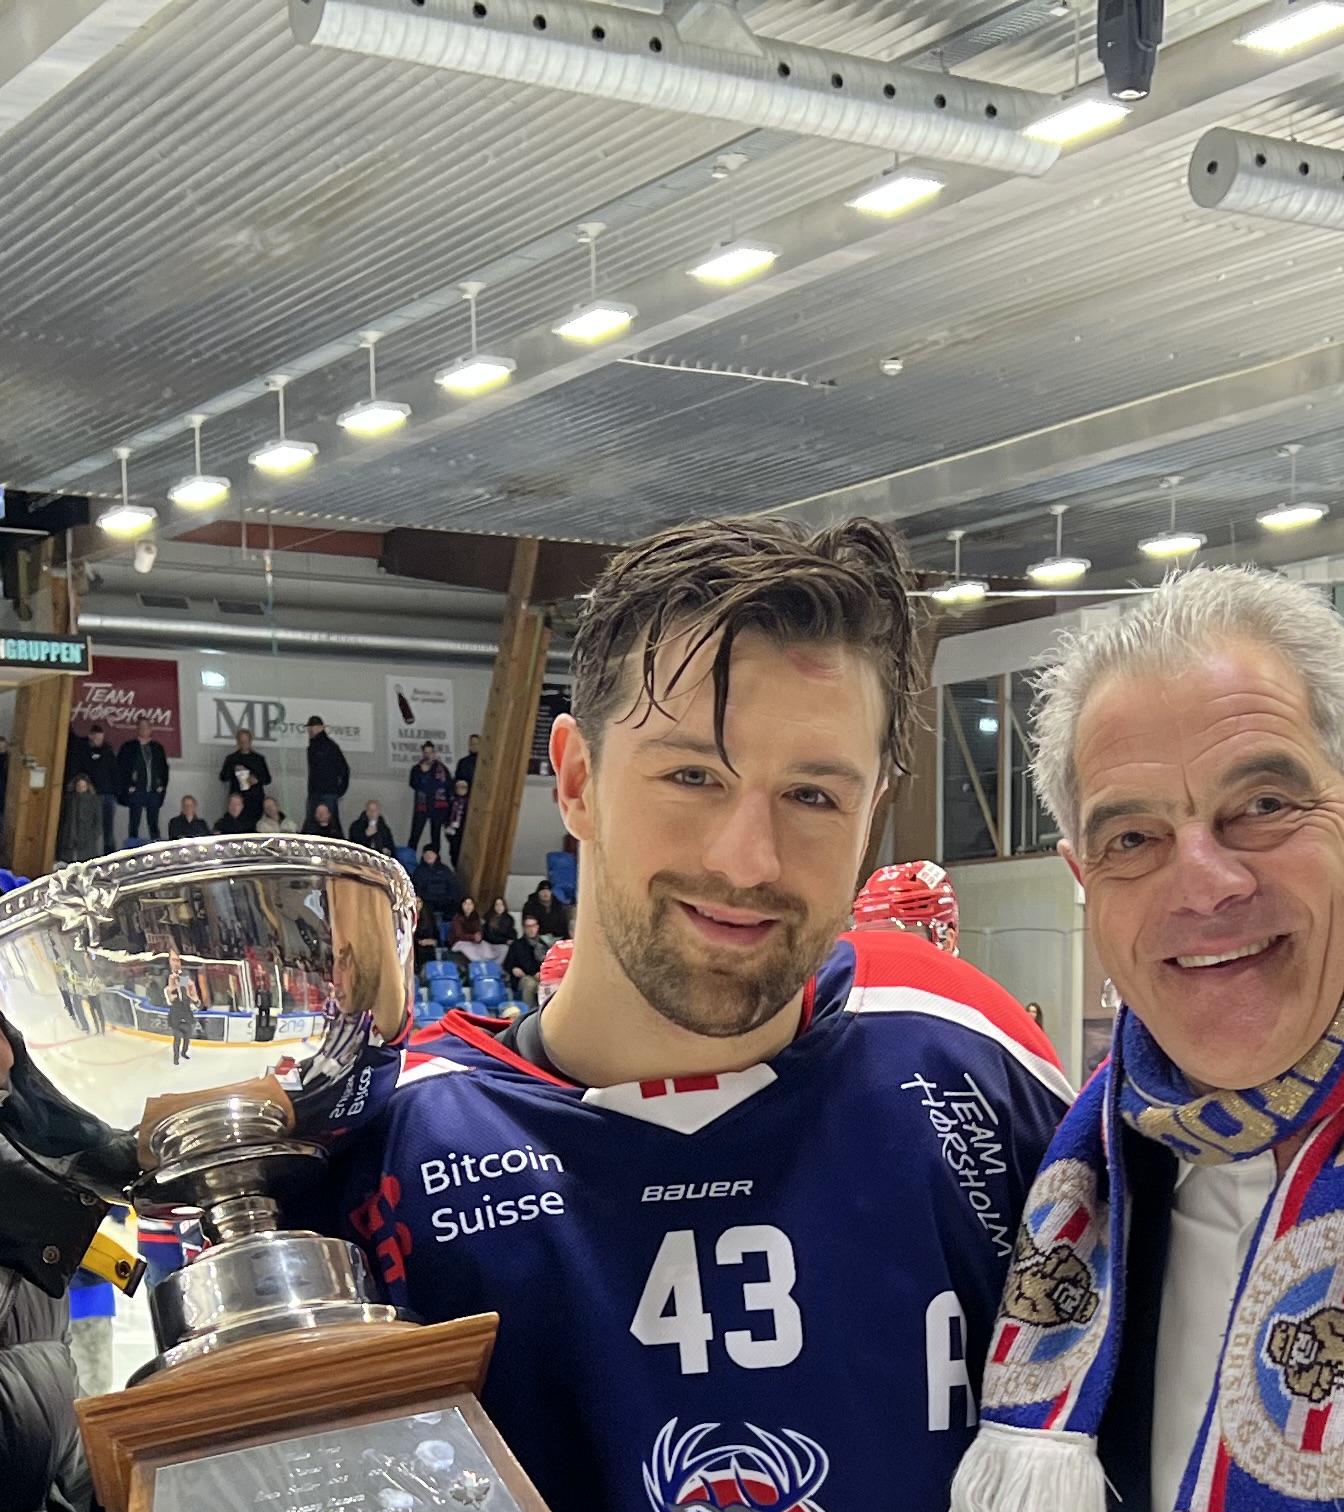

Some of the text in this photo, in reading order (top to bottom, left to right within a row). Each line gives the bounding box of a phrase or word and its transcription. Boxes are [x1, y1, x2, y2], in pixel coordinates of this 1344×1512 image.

[82, 682, 136, 705] TEAM
[213, 698, 287, 742] MP
[944, 1072, 1008, 1176] TEAM
[421, 1143, 565, 1195] Bitcoin
[641, 1179, 754, 1203] BAUER
[900, 1073, 1014, 1258] HØRSHOLM
[430, 1189, 565, 1243] Suisse
[630, 1225, 804, 1375] 43
[925, 1290, 977, 1433] A
